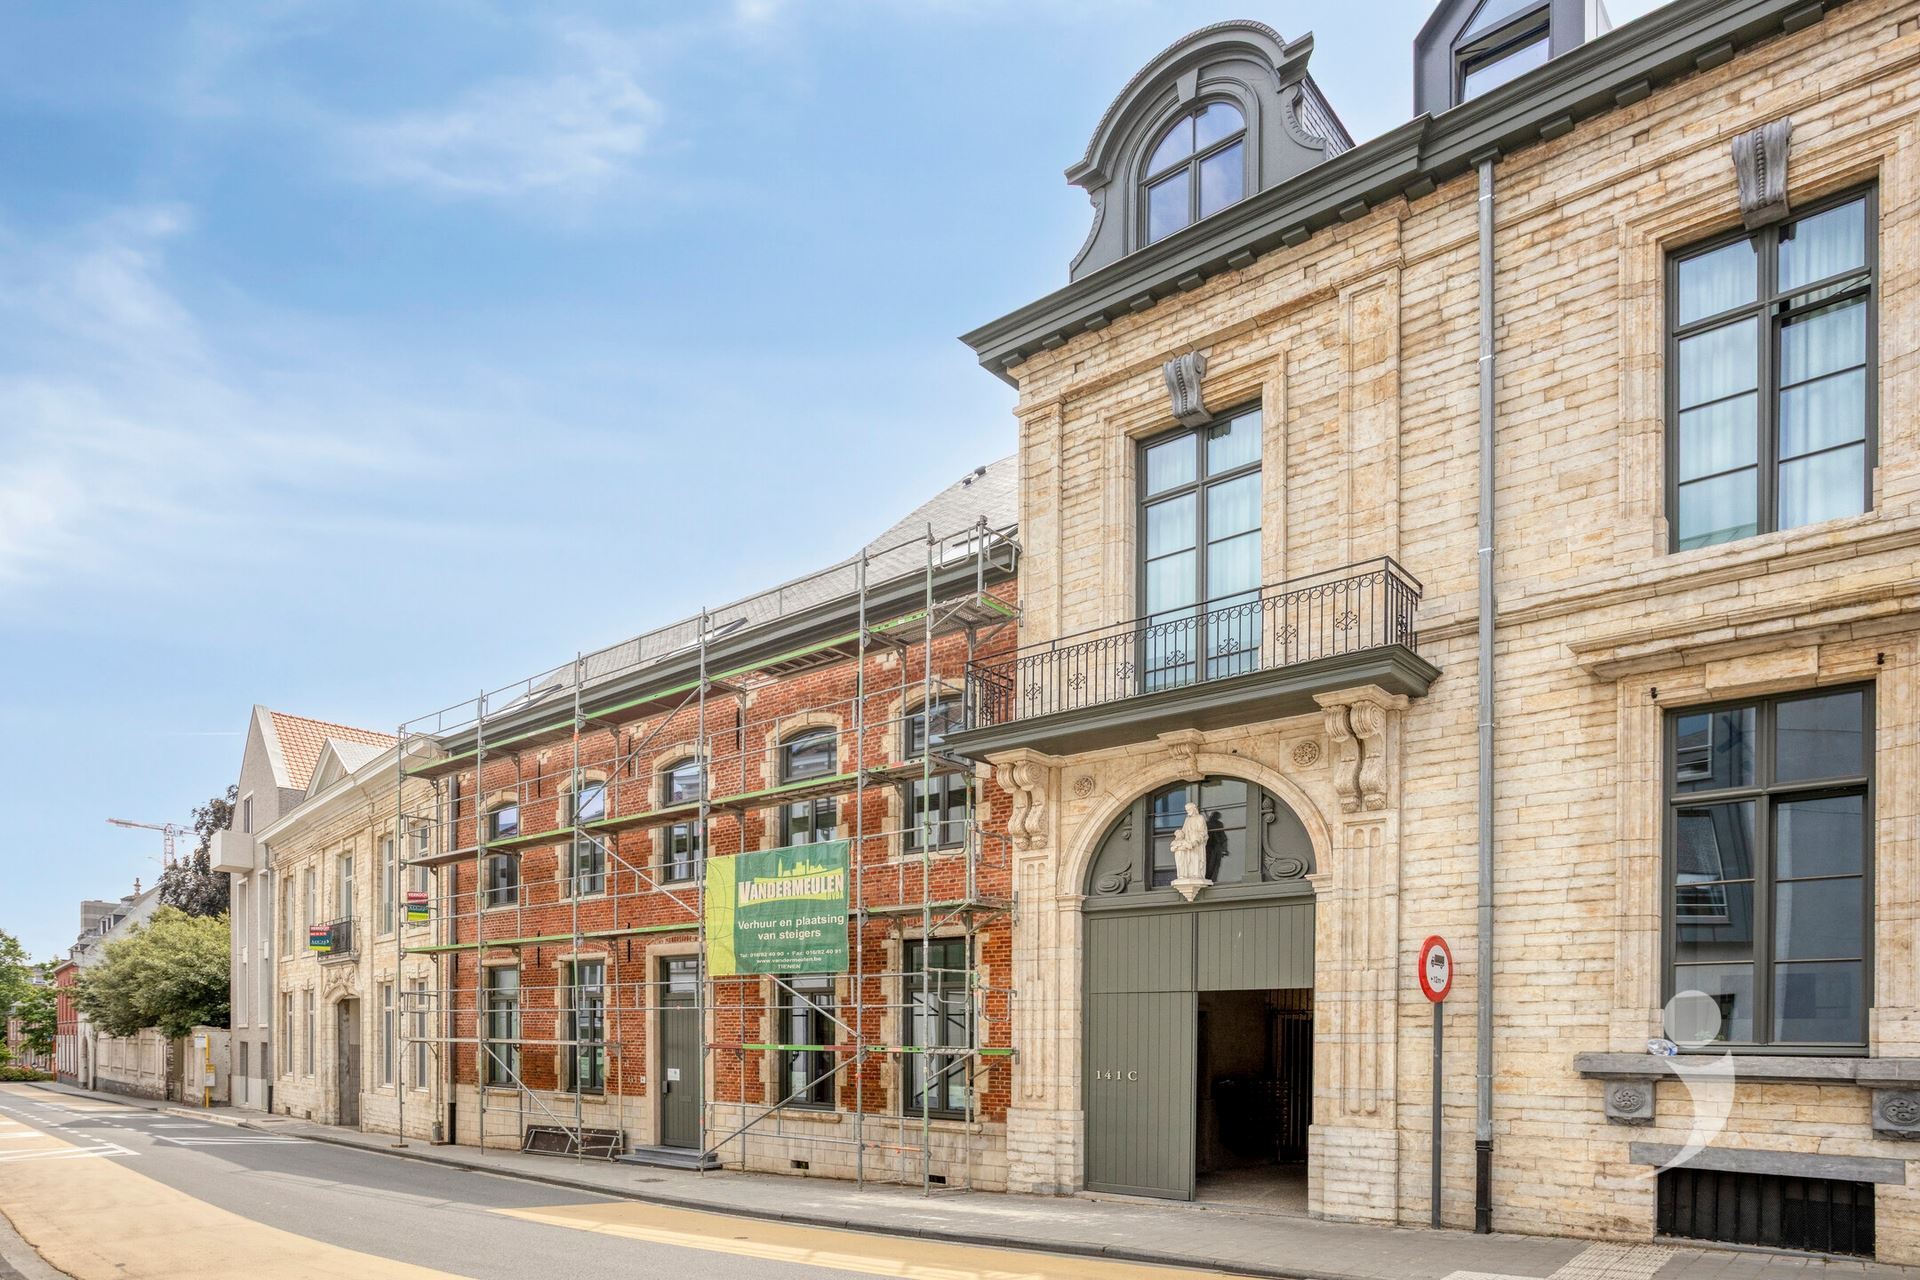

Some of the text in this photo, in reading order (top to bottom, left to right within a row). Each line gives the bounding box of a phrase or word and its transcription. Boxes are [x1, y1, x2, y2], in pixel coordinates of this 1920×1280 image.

[738, 874, 843, 906] VANDERMEULEN
[738, 914, 844, 930] Verhuur en plaatsing
[758, 929, 821, 940] van steigers
[1096, 1069, 1138, 1081] 141 C
